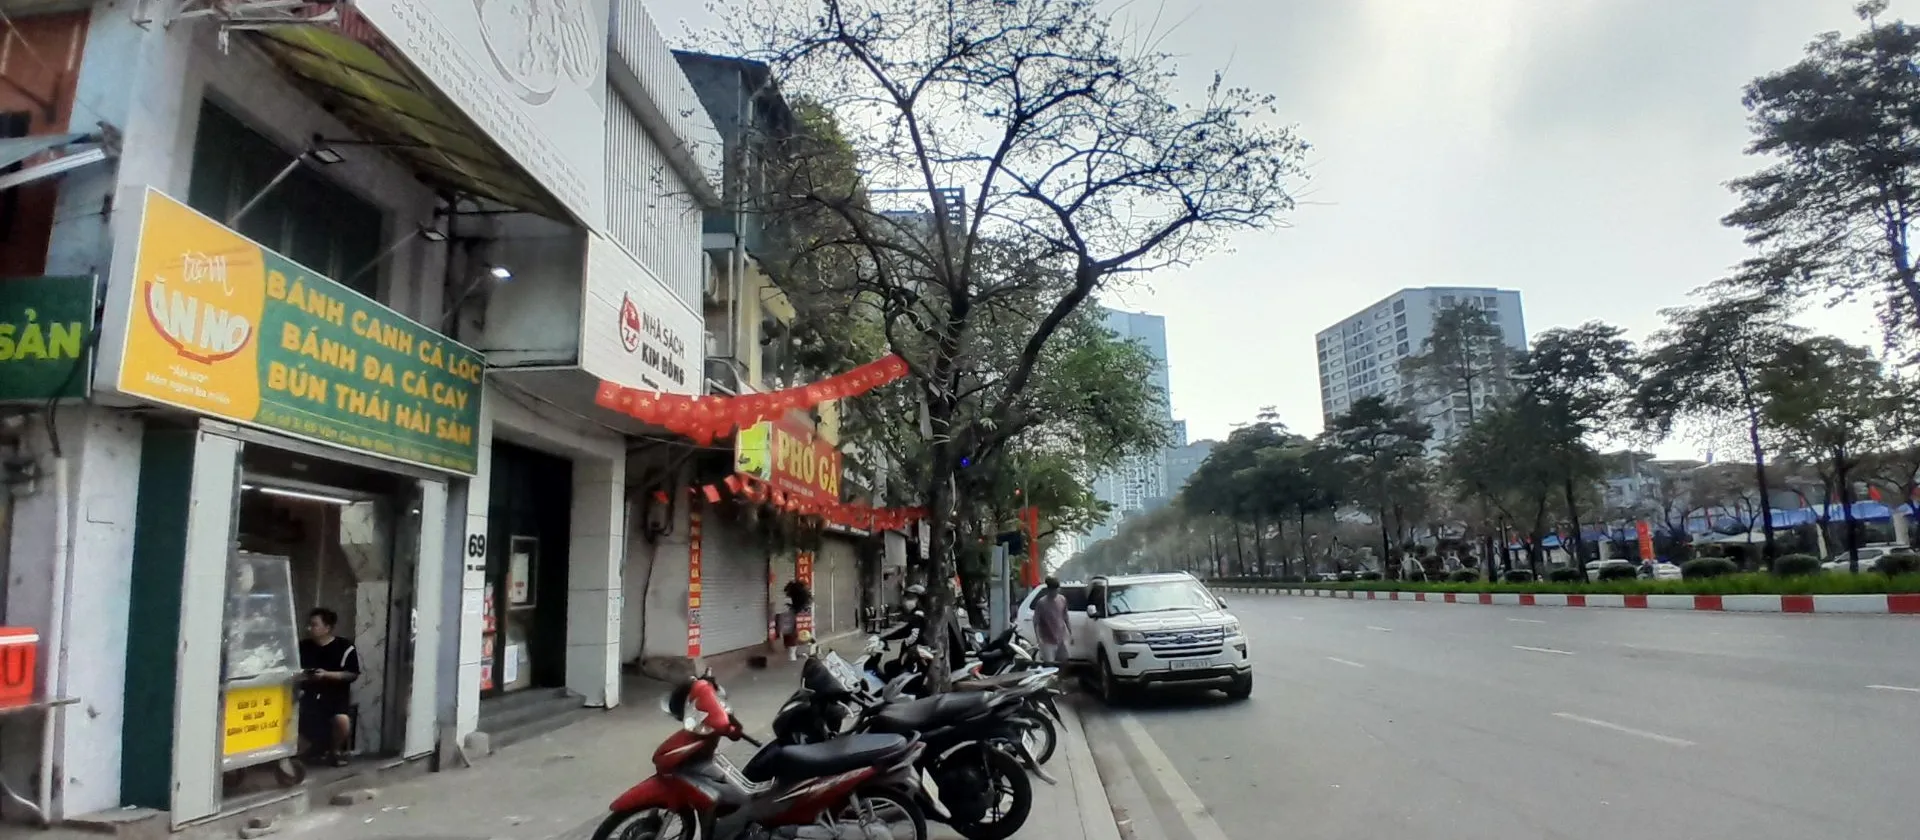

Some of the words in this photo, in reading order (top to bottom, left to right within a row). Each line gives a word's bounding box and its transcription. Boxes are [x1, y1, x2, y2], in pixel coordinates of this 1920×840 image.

[0, 308, 82, 361] SẢN
[151, 274, 198, 344] ĂN
[200, 303, 250, 353] NO
[266, 270, 345, 326] BÁNH
[352, 310, 414, 355] CANH
[419, 340, 444, 369] CÁ
[449, 353, 481, 384] LÓC
[642, 311, 662, 343] NHÀ
[662, 328, 685, 359] SÁCH
[281, 321, 357, 372] BÁNH
[363, 355, 395, 387] ĐA
[402, 370, 429, 398] CÁ
[432, 382, 468, 410] CAY
[641, 342, 659, 371] KIM
[661, 352, 685, 386] ĐỒNG
[268, 361, 328, 404] BÚN
[334, 383, 390, 422] THÁI
[395, 401, 431, 434] HẢI
[436, 414, 471, 445] SẢN
[776, 429, 815, 484] PHỞ
[818, 453, 838, 497] GÀ
[469, 534, 485, 557] 69
